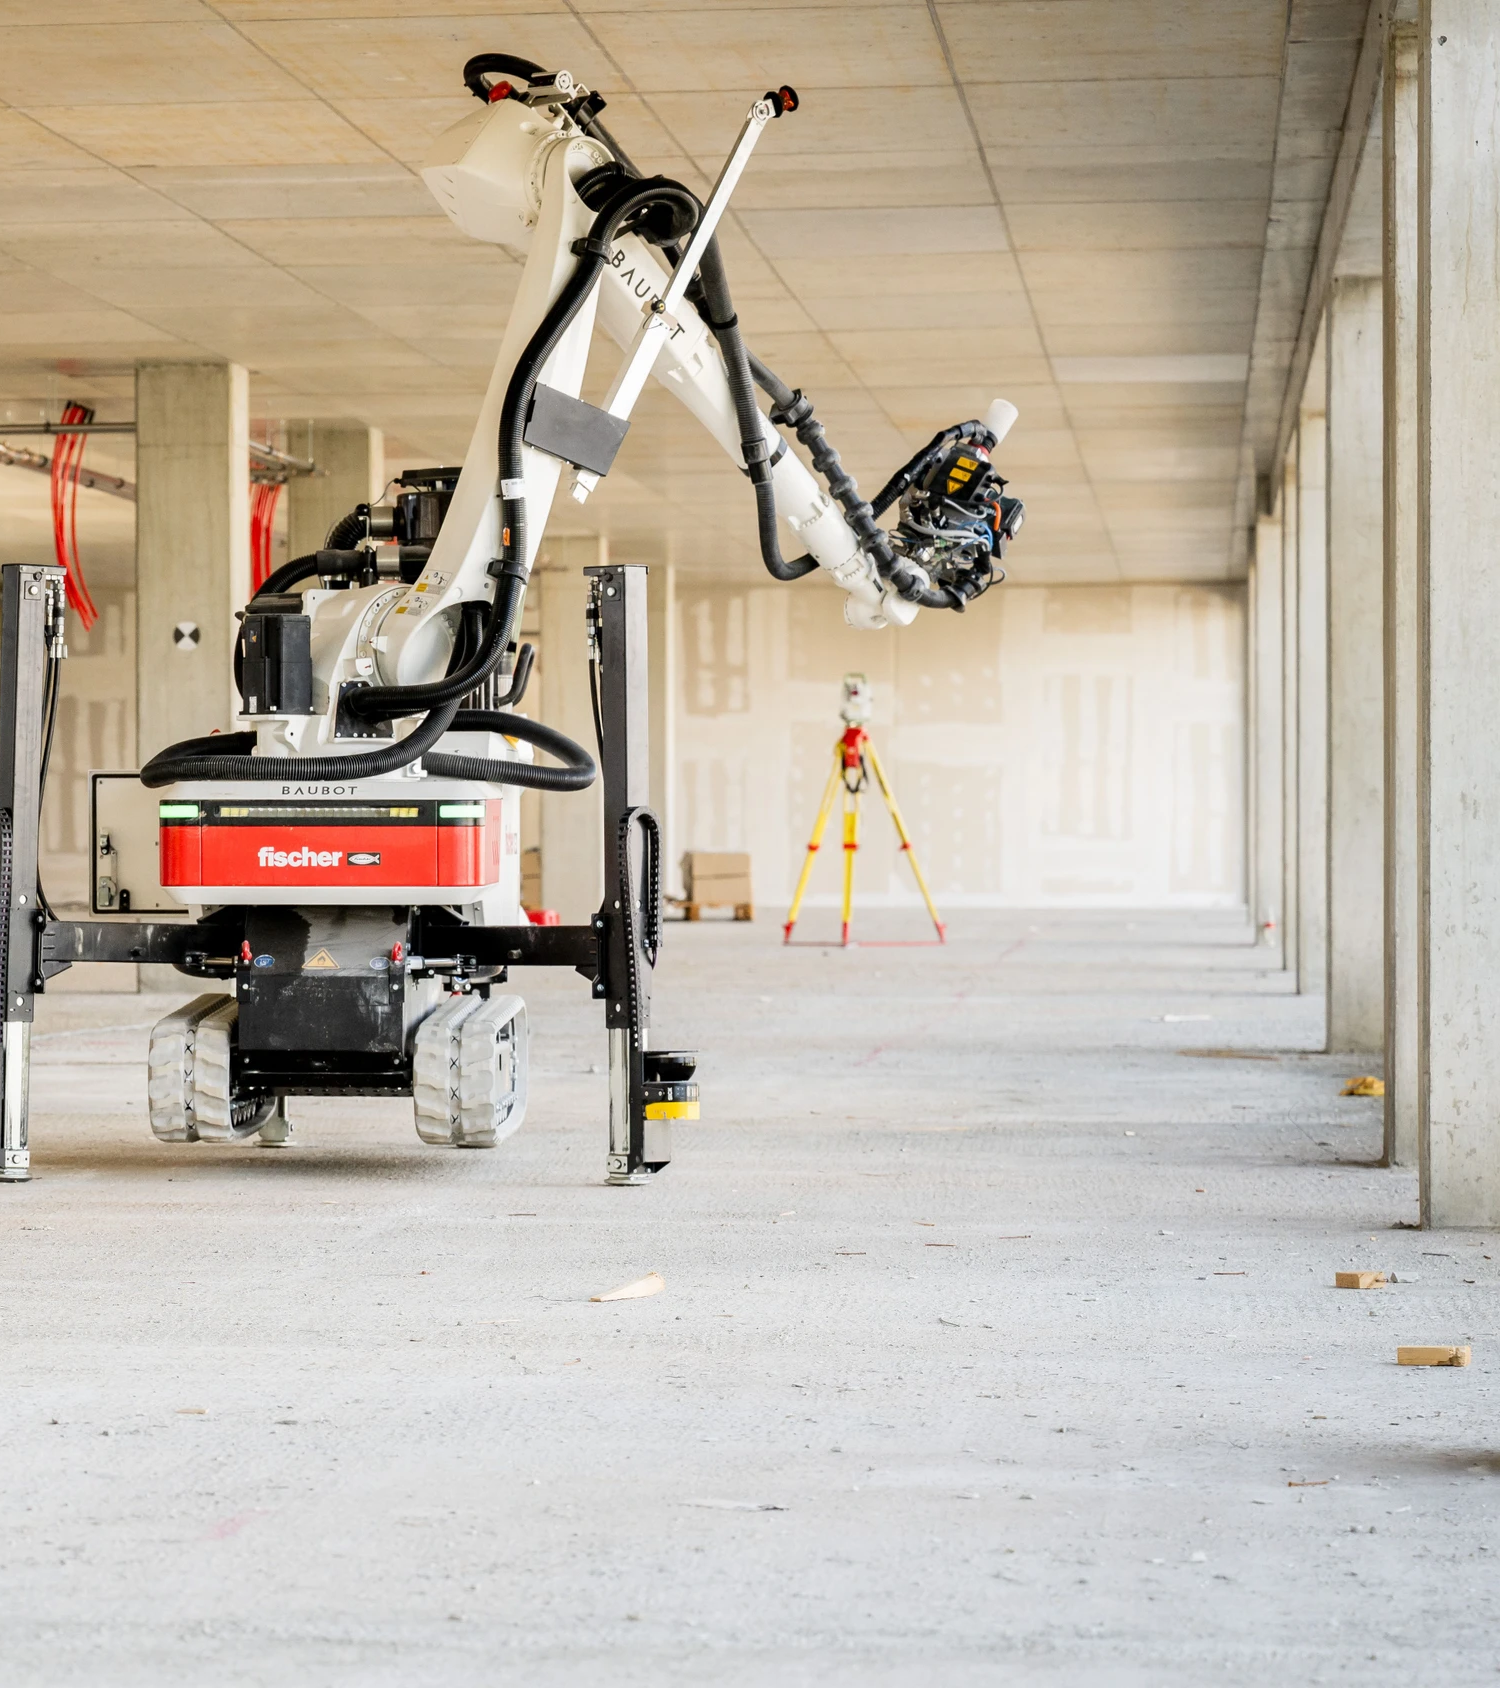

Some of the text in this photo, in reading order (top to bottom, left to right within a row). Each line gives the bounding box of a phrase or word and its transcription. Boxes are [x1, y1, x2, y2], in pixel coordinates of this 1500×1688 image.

[611, 249, 685, 340] BAUT
[281, 786, 358, 795] BAUBOT
[257, 846, 343, 867] fischer
